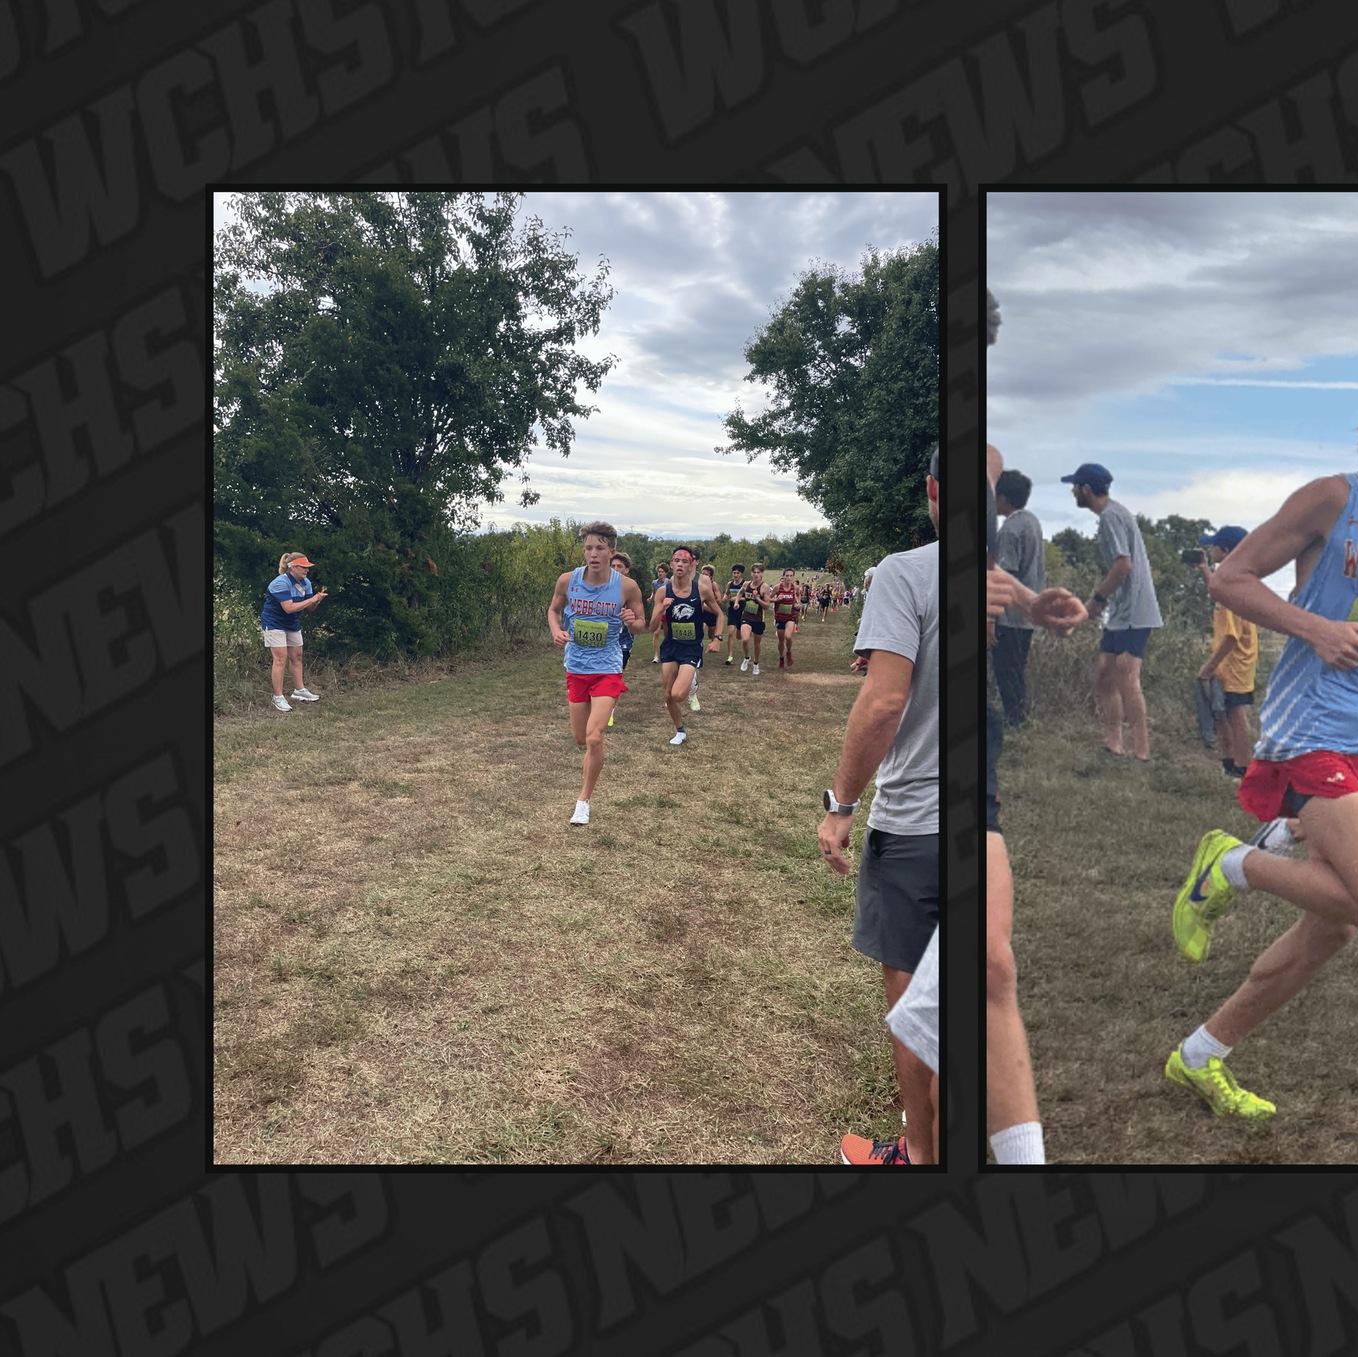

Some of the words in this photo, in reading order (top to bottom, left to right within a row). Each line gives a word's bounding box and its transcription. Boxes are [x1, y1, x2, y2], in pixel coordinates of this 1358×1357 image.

[569, 597, 594, 615] WEBB
[595, 601, 617, 617] CITY
[577, 630, 603, 642] 1430
